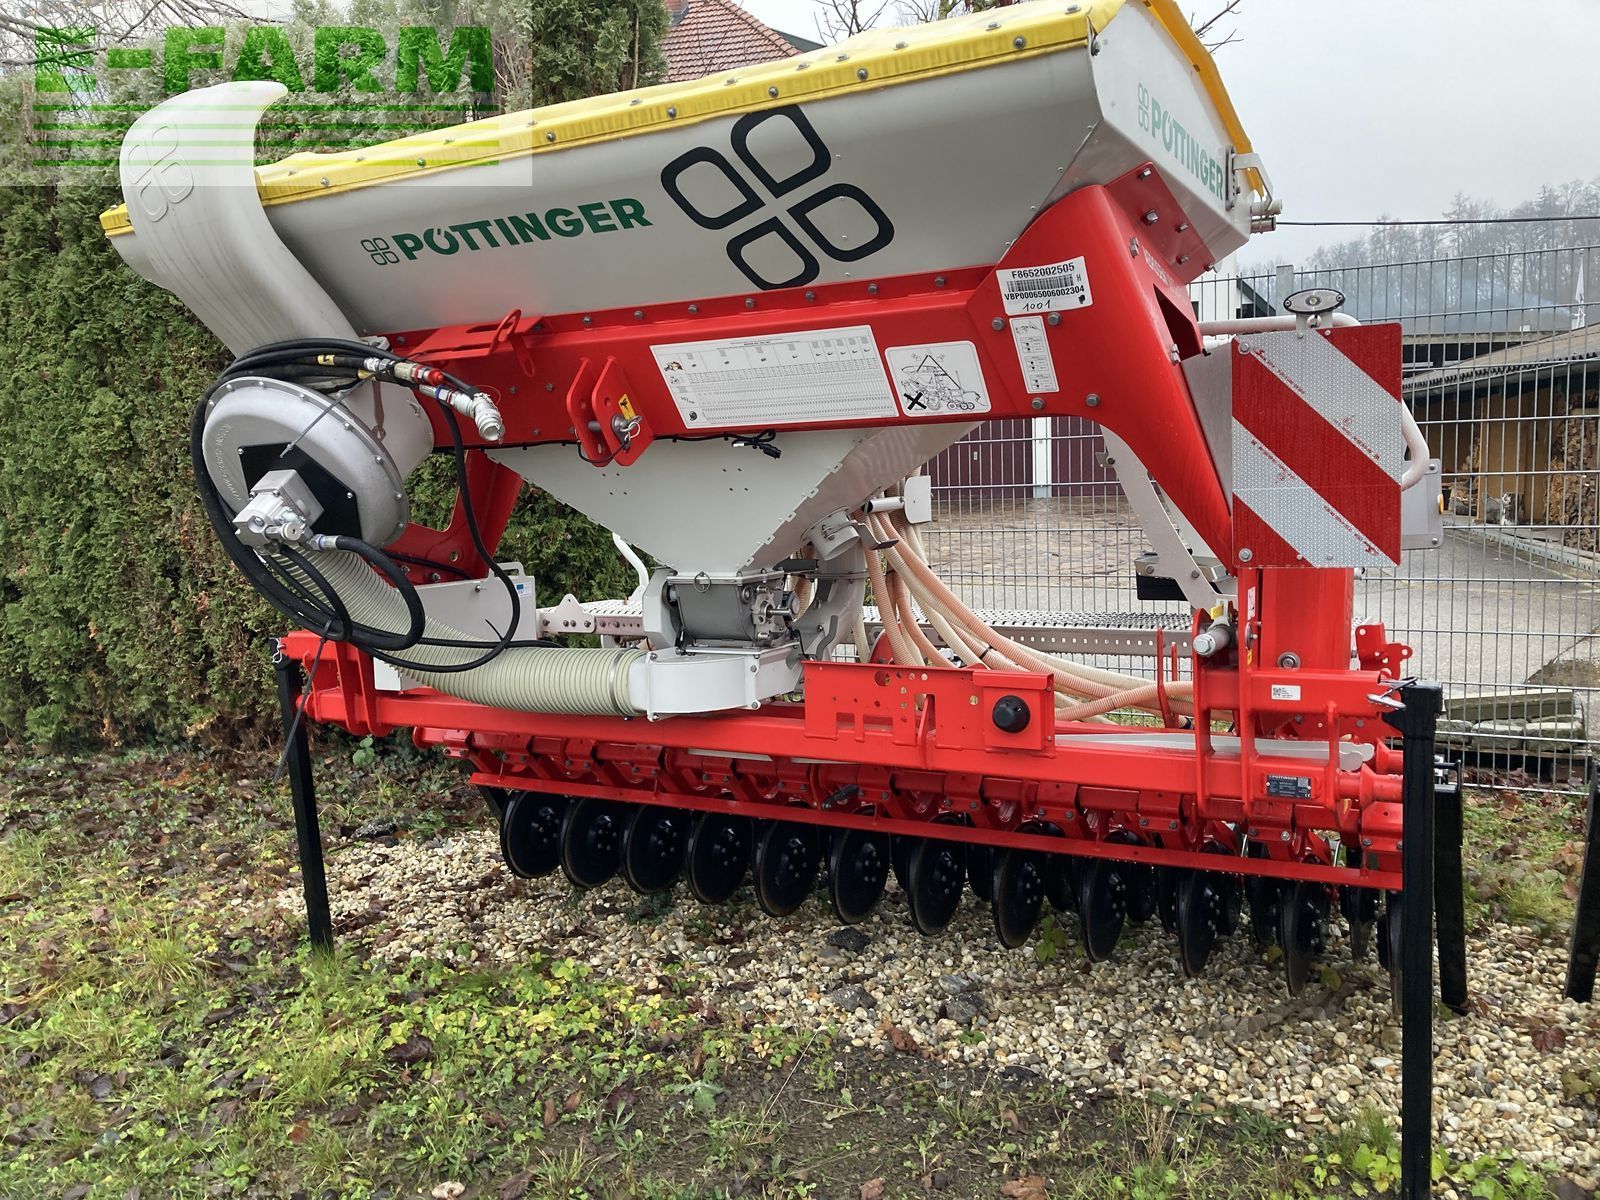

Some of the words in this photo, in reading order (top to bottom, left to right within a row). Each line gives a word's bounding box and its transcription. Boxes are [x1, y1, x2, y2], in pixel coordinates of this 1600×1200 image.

[1151, 97, 1223, 201] PÖTTINGER
[391, 197, 654, 261] PÖTTINGER
[1011, 262, 1075, 279] F8652002505
